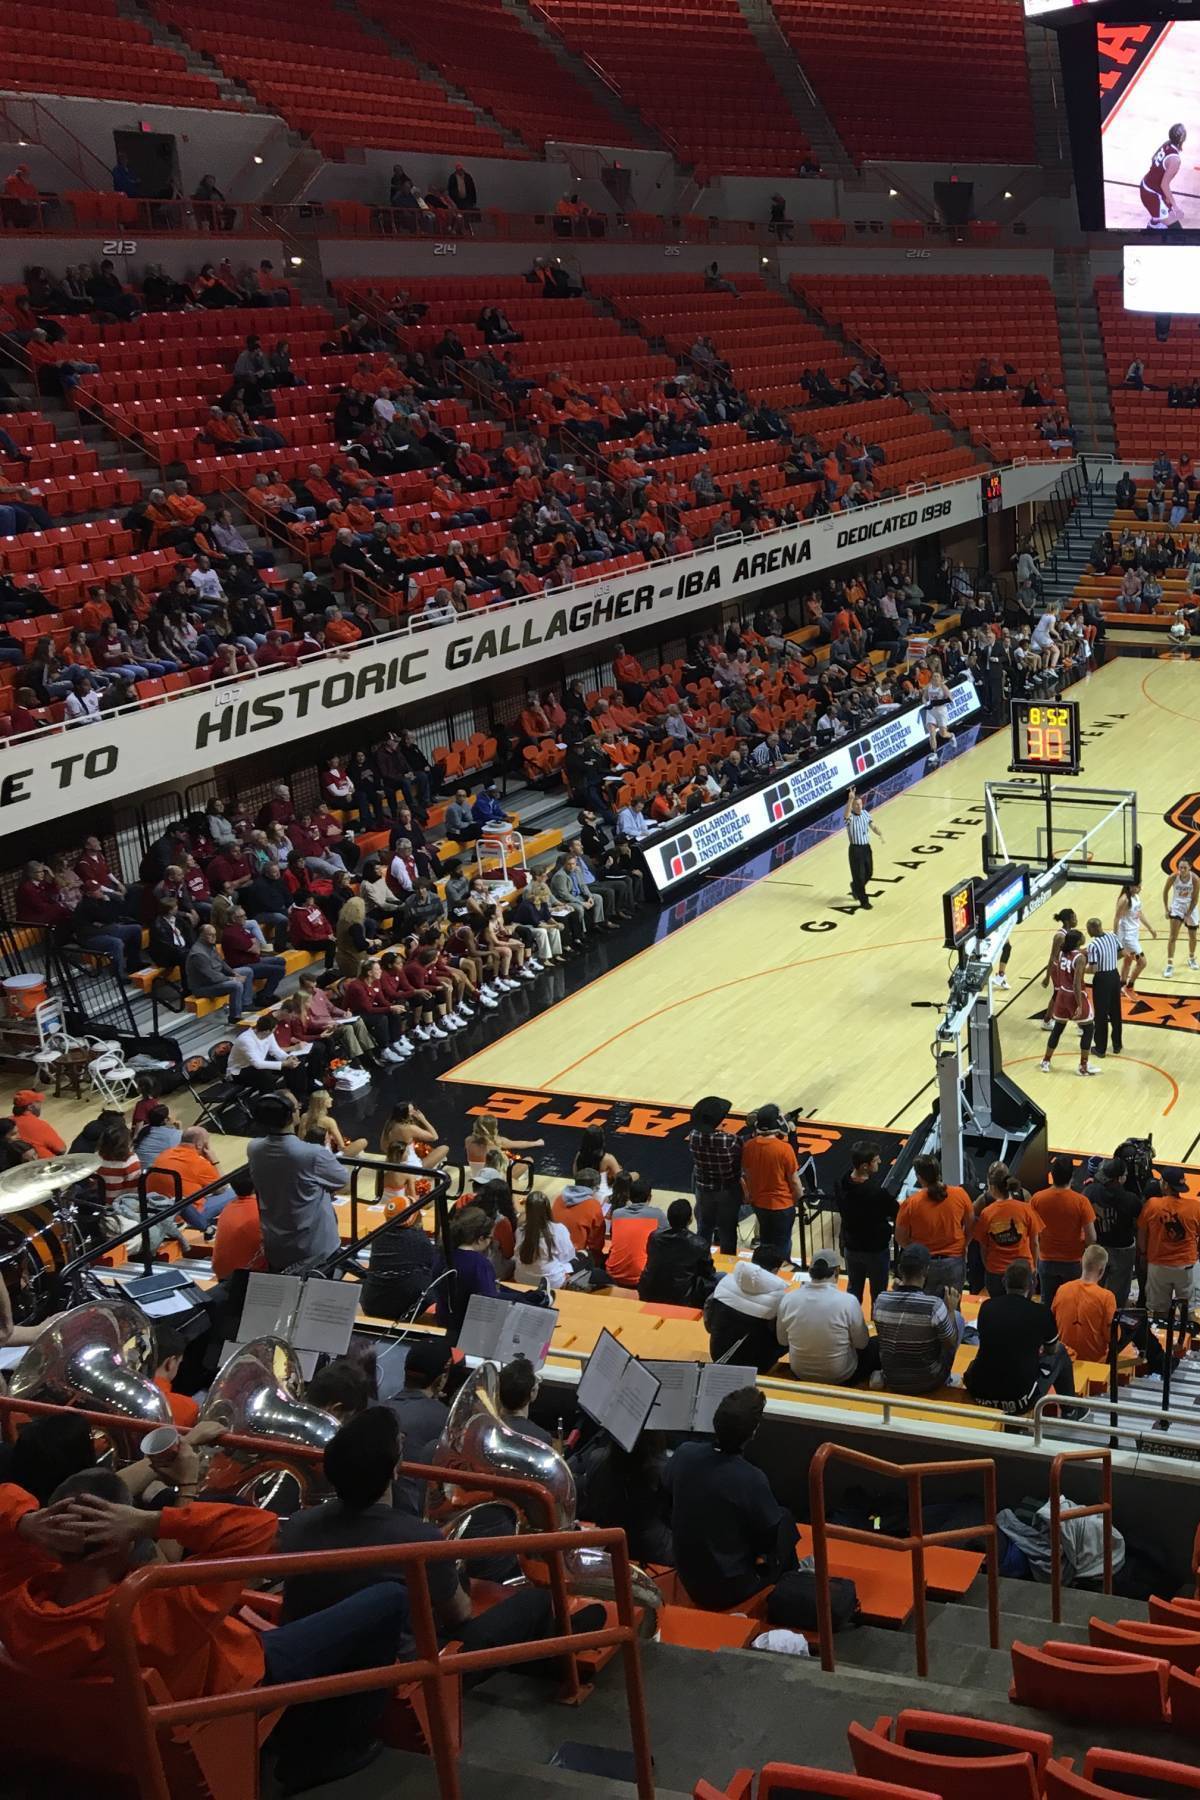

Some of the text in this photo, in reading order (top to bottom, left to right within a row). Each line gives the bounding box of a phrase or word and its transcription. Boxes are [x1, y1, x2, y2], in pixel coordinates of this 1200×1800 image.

[103, 240, 137, 254] 213
[433, 243, 456, 255] 214
[664, 246, 680, 256] 215
[906, 248, 931, 258] 216
[51, 745, 119, 788] TO
[196, 649, 429, 749] HISTORIC
[732, 539, 811, 584] ARENA
[836, 509, 918, 549] DEDICATED
[921, 499, 952, 525] 1938
[1029, 707, 1067, 726] 8:52
[870, 720, 903, 744] OKLAHOMA
[873, 725, 912, 754] FARM BUREAU
[1027, 727, 1063, 759] 30
[875, 738, 908, 763] INSURANCE
[790, 761, 828, 787] OKLAHOMA
[792, 766, 839, 798] FARM BUREAU
[796, 782, 833, 808] INSURANCE
[692, 809, 738, 840] OKLAHOMA
[696, 813, 751, 851] FARM BUREAU
[699, 830, 745, 862] INSURANCE
[1060, 957, 1072, 973] 24
